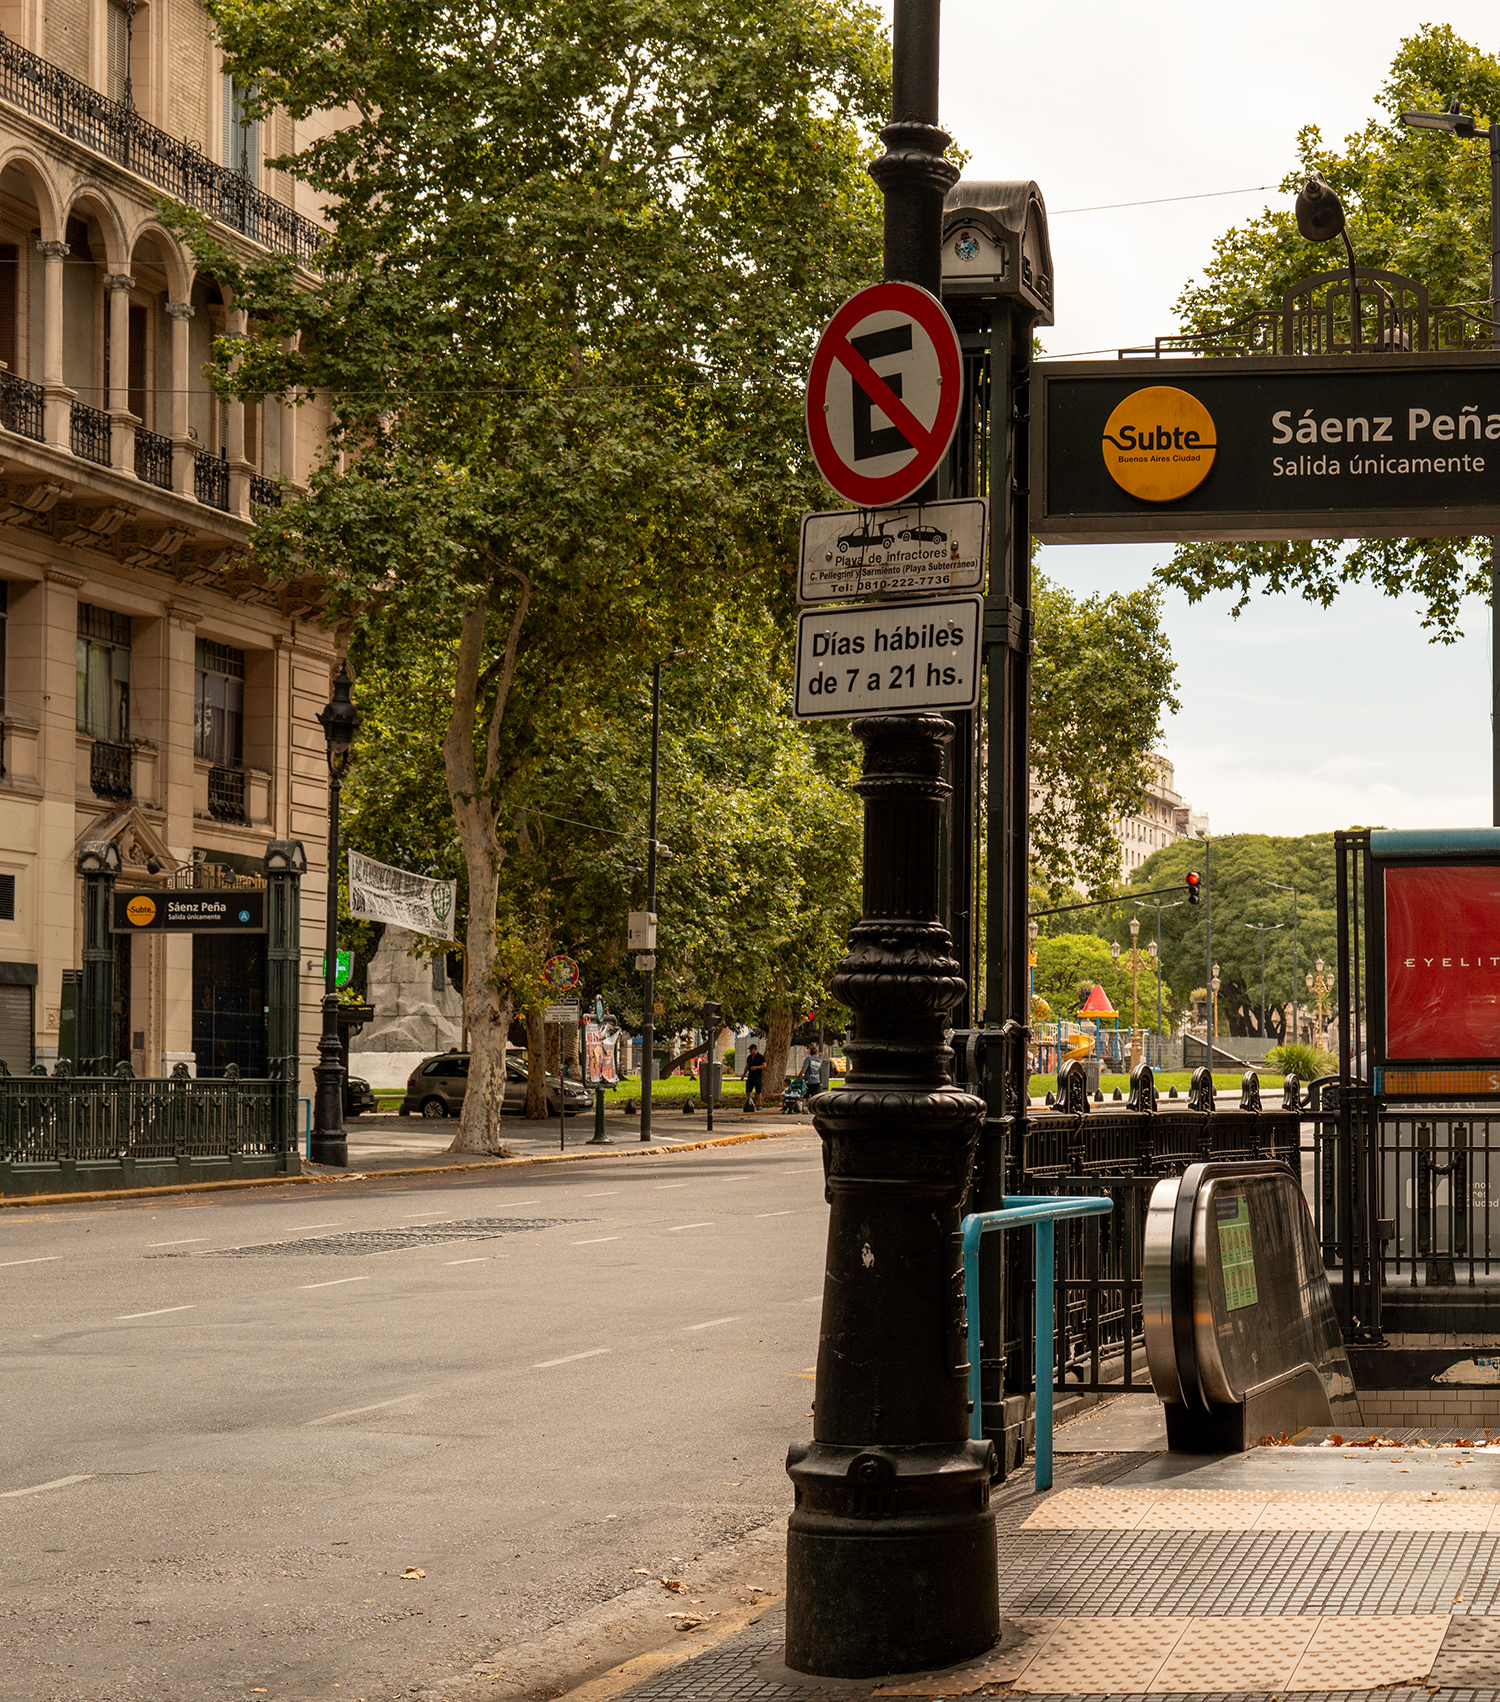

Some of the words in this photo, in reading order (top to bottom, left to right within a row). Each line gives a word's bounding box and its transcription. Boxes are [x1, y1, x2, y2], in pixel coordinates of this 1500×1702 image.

[1271, 409, 1393, 445] Sáenz
[1115, 425, 1203, 451] Subte
[1118, 455, 1149, 463] Buenos
[1172, 454, 1201, 462] Ciudad
[1273, 456, 1341, 476] Salida
[1349, 453, 1485, 475] únicamente
[835, 555, 863, 567] Playa
[868, 553, 882, 564] de
[886, 549, 948, 562] infractores
[810, 573, 818, 581] C.
[819, 569, 854, 580] Pellegrini
[862, 566, 901, 577] Sarmiento
[902, 564, 927, 575] (Playa
[928, 559, 978, 571] Subterránea)
[831, 583, 853, 593] Tel:
[857, 575, 950, 591] 0810-222-7736
[813, 631, 865, 657] Días
[874, 623, 964, 652] hábiles
[808, 671, 838, 695] de
[846, 669, 860, 692] 7
[867, 672, 880, 691] a
[888, 664, 916, 689] 21
[926, 662, 963, 687] hs.
[168, 902, 199, 912] Sáenz
[201, 901, 227, 912] Peña
[240, 912, 249, 920] A
[1404, 957, 1500, 968] EYELIT
